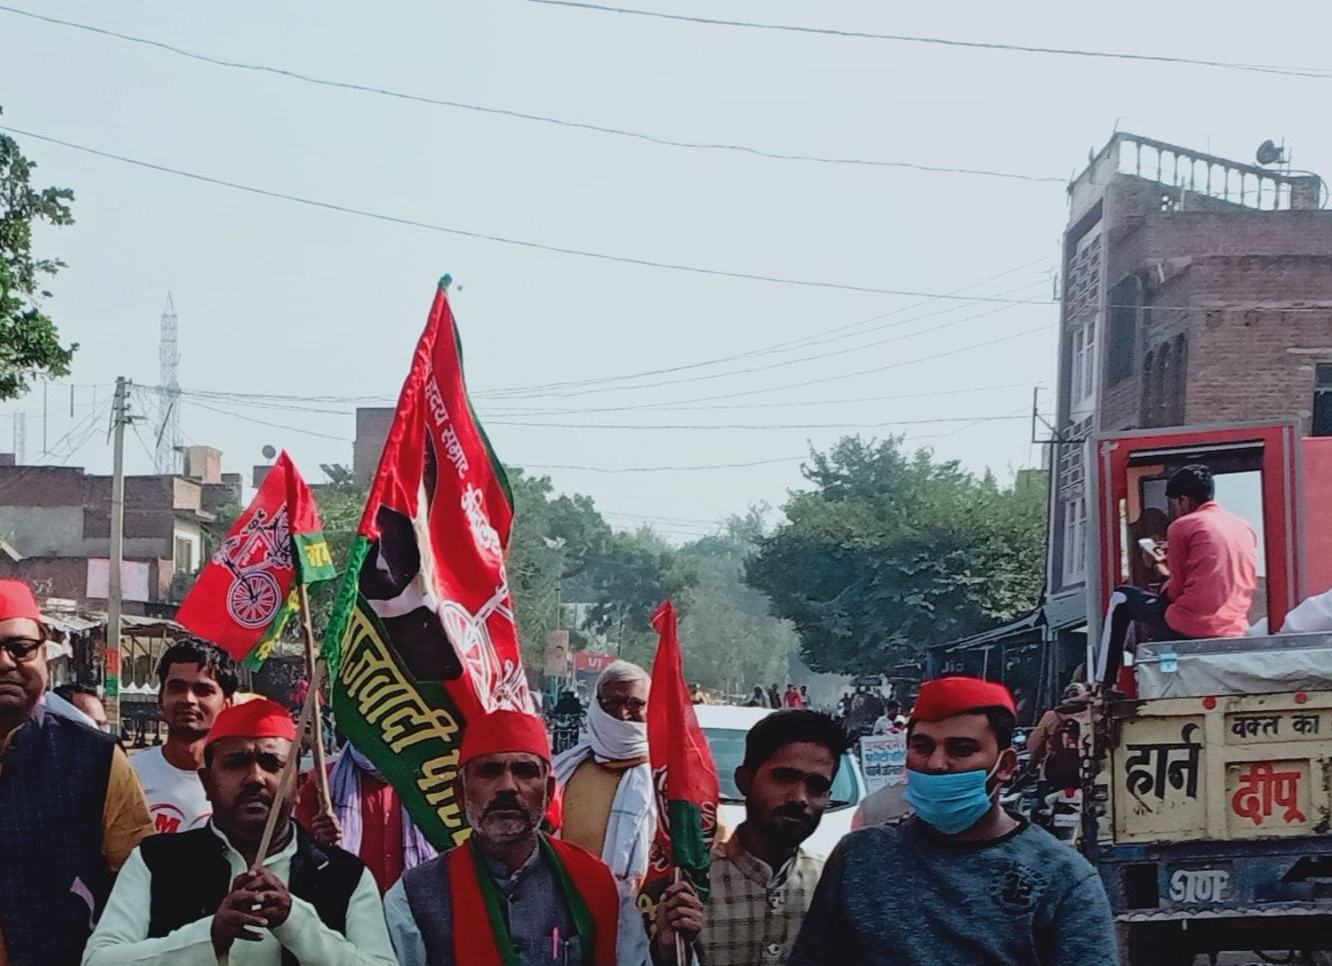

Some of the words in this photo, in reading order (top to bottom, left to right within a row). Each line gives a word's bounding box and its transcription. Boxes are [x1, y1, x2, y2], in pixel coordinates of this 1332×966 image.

[1231, 715, 1283, 739] वक्त
[1292, 714, 1320, 735] का
[1169, 869, 1231, 903] STOP
